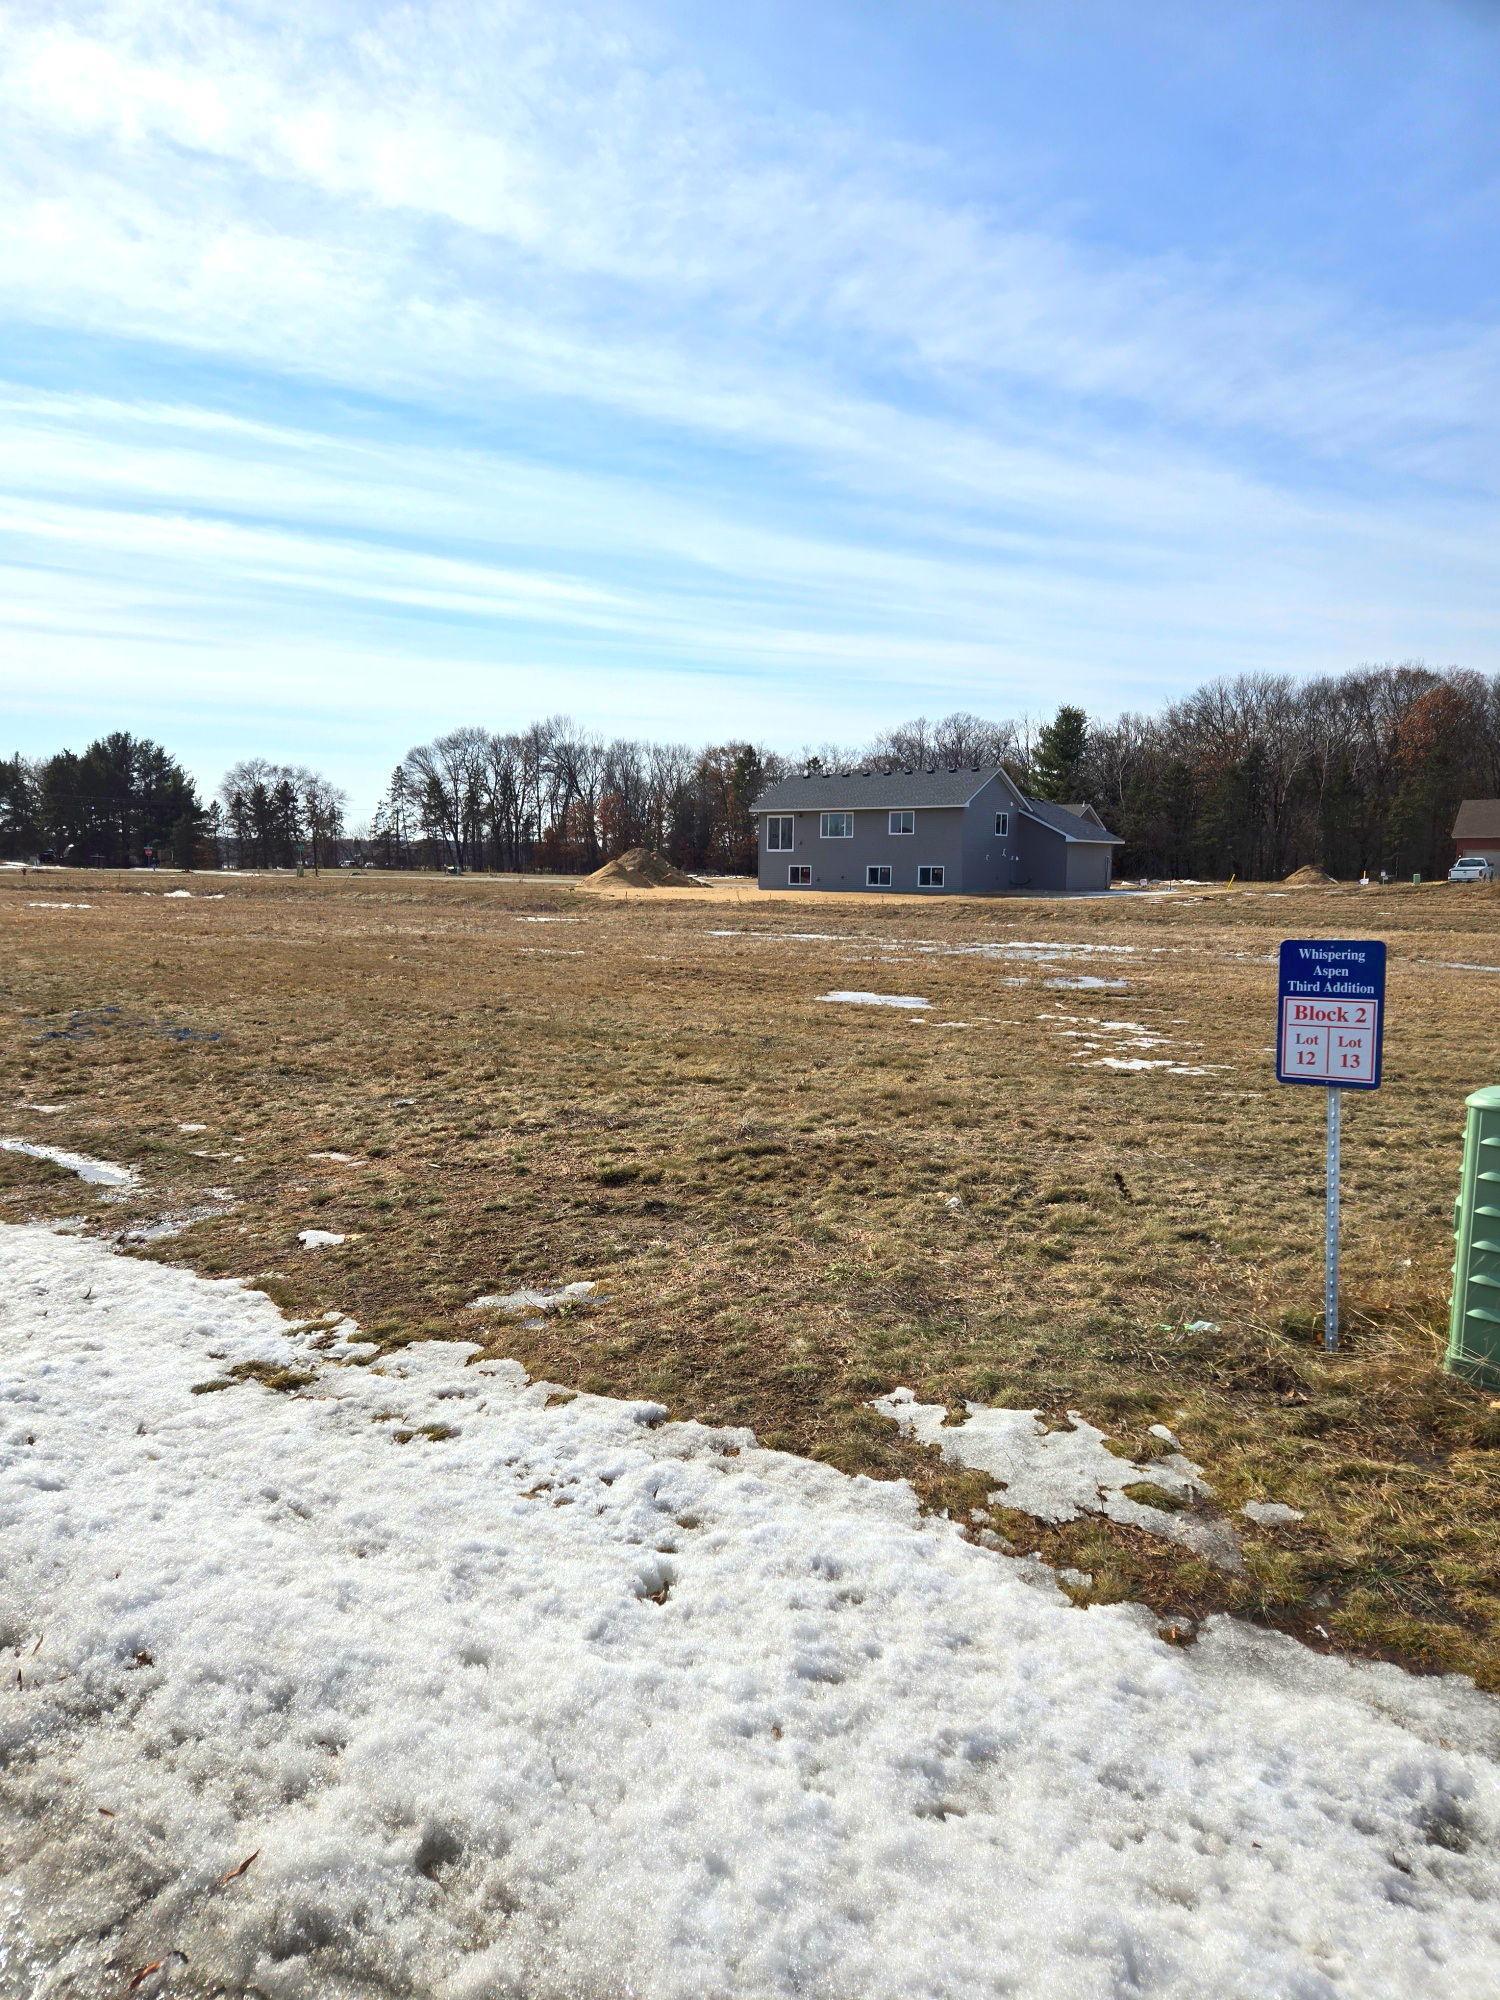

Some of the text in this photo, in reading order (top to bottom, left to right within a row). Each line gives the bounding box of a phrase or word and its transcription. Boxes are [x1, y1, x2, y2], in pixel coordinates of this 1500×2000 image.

[1299, 949, 1365, 963] Whispering
[1313, 965, 1349, 978] Aspen
[1288, 980, 1374, 994] Third Addition
[1295, 1005, 1366, 1023] Block 2
[1296, 1034, 1319, 1045] Lot
[1338, 1036, 1362, 1048] Lot
[1297, 1051, 1315, 1065] 12
[1341, 1054, 1360, 1068] 13
